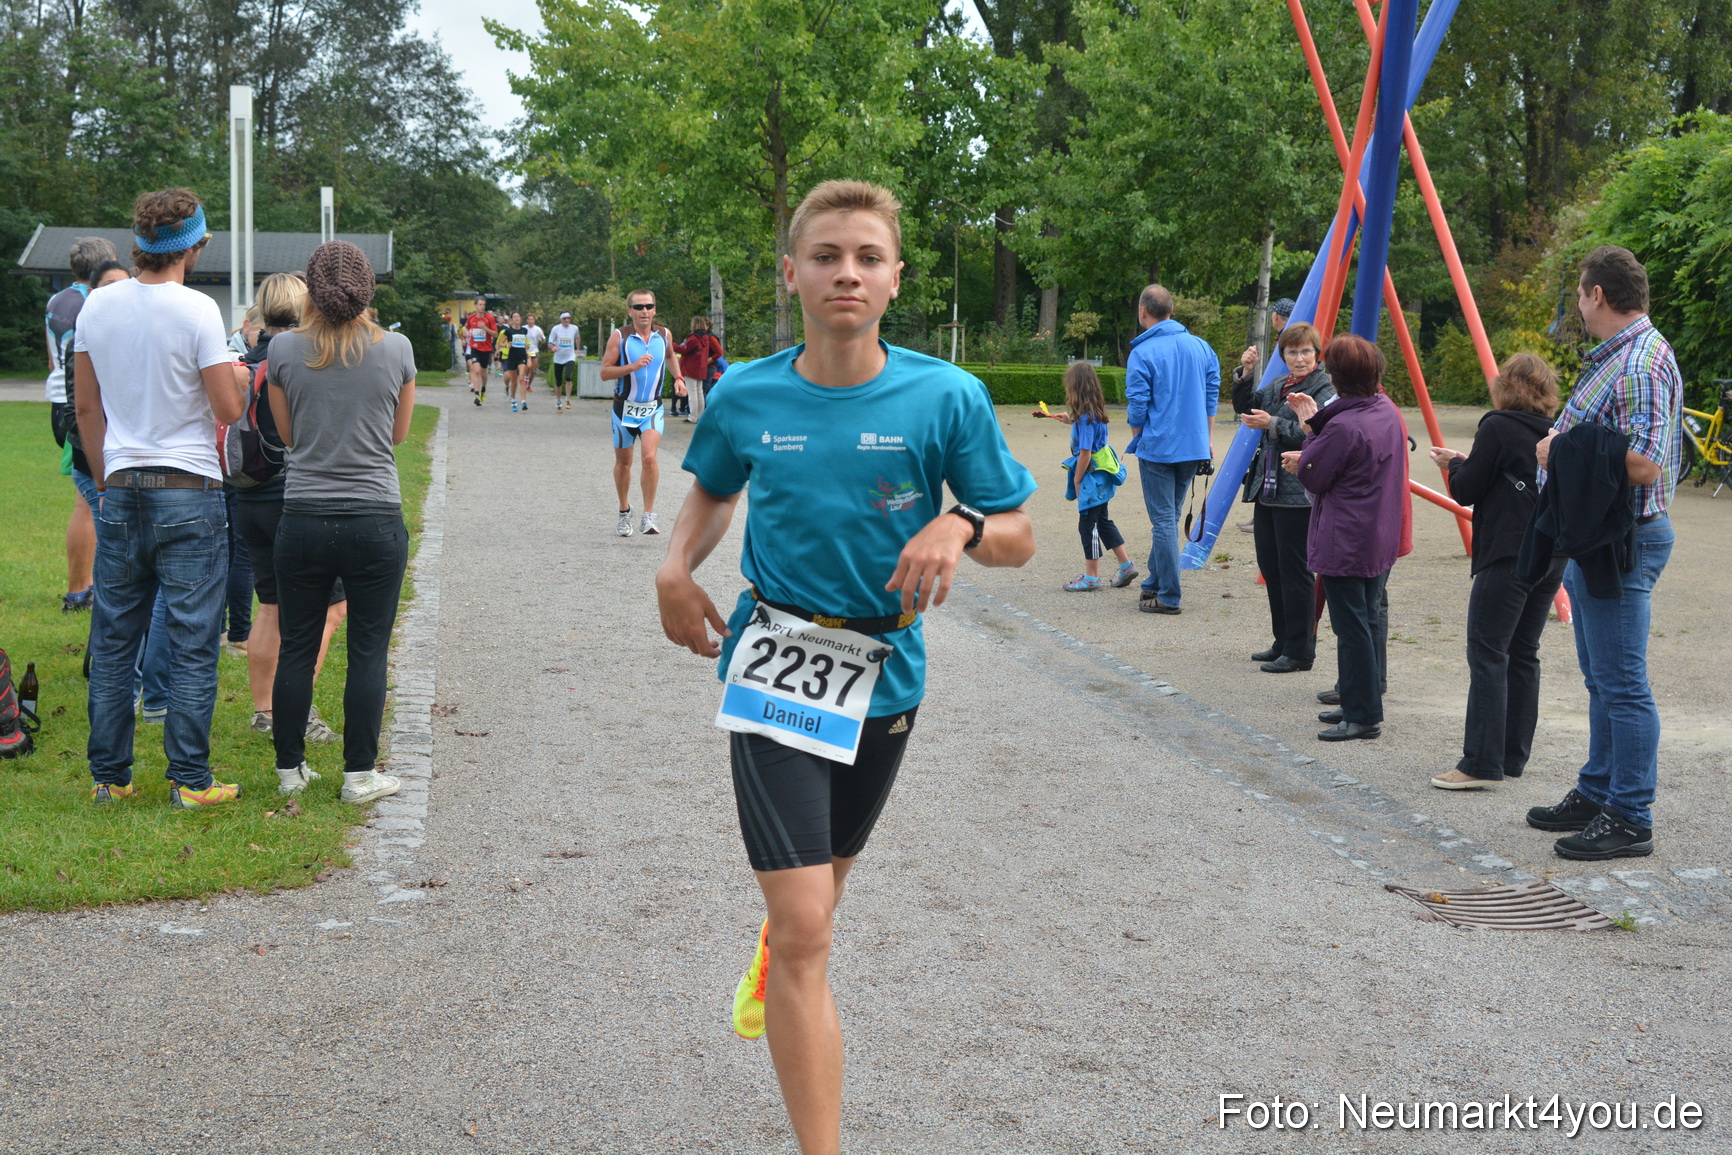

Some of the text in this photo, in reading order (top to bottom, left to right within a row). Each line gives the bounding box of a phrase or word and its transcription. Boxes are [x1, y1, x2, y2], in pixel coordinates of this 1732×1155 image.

[626, 405, 654, 417] 2127
[773, 435, 807, 443] Sparkasse
[862, 433, 877, 444] DB
[773, 443, 803, 452] Bamberg
[125, 474, 165, 488] PMA
[797, 632, 862, 656] Neumarkt
[743, 637, 866, 707] 2237
[763, 700, 822, 734] Daniel
